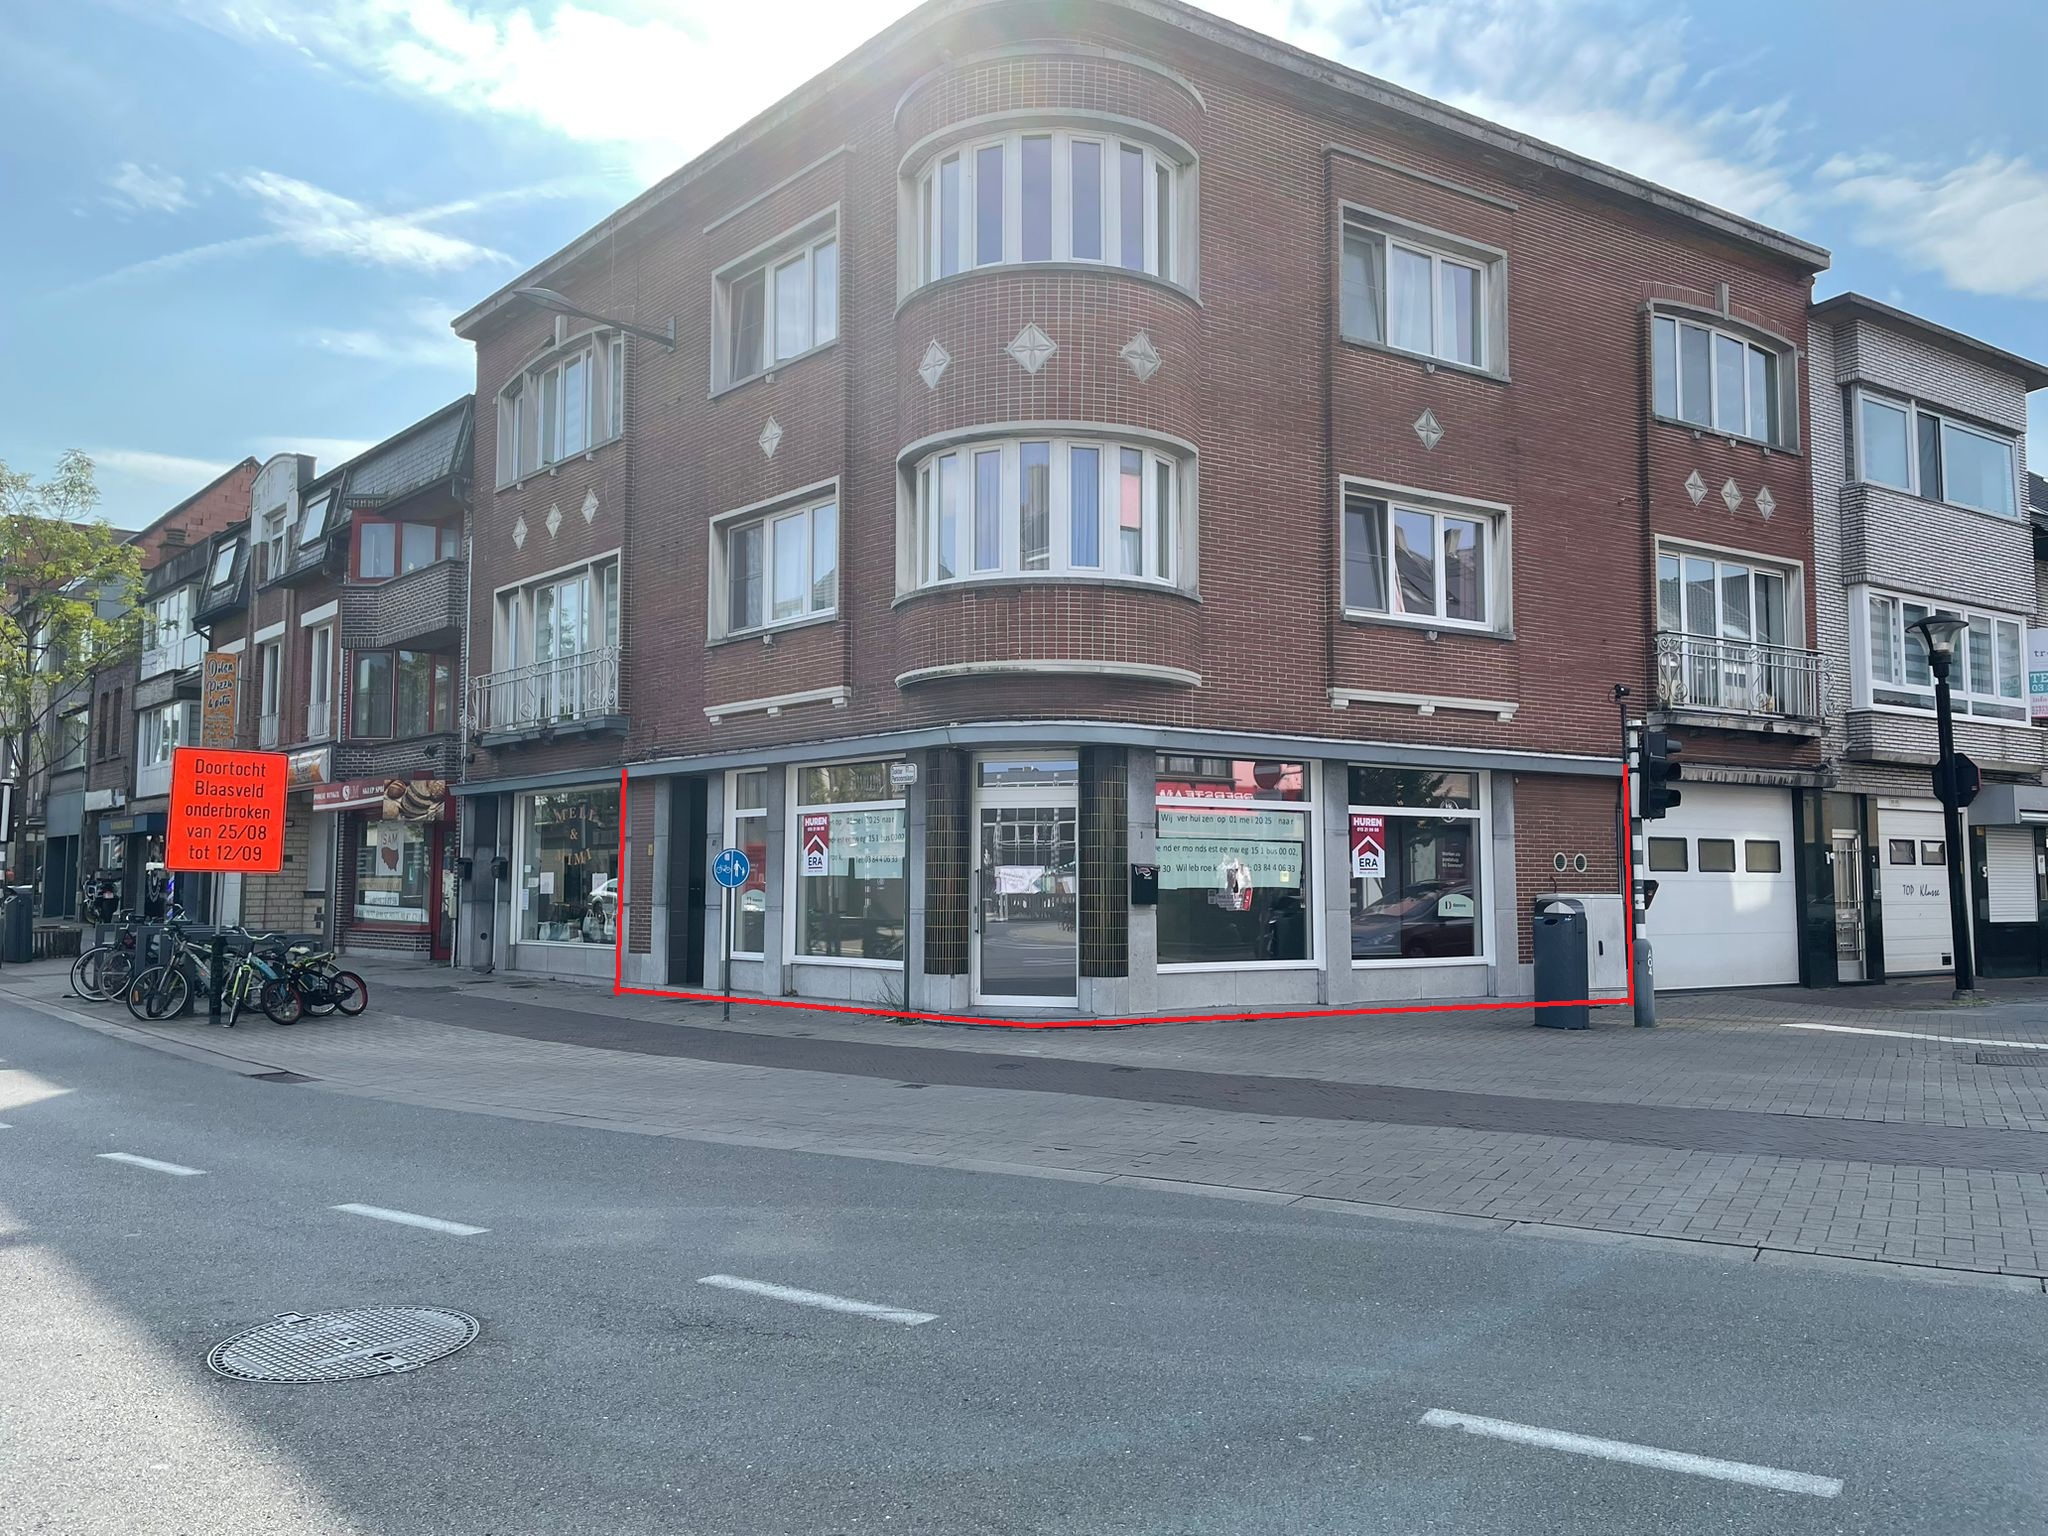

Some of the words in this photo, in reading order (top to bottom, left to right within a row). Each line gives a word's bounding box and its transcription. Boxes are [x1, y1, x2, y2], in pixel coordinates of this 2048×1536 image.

[206, 681, 232, 696] Pizza
[196, 758, 266, 778] Doortocht
[195, 780, 264, 798] Blaasveld
[185, 802, 270, 820] onderbroken
[804, 816, 828, 826] HUREN
[1160, 814, 1172, 824] Wij
[1216, 816, 1226, 824] op
[1229, 816, 1237, 824] 01
[1354, 817, 1382, 827] HUREN
[187, 826, 212, 838] van
[218, 824, 266, 840] 25/08
[570, 828, 578, 840] &
[383, 832, 398, 846] SAM
[189, 845, 210, 860] tot
[218, 846, 262, 861] 12/09
[808, 857, 822, 866] ERA
[1359, 858, 1378, 867] ERA
[1903, 884, 1914, 895] TOP
